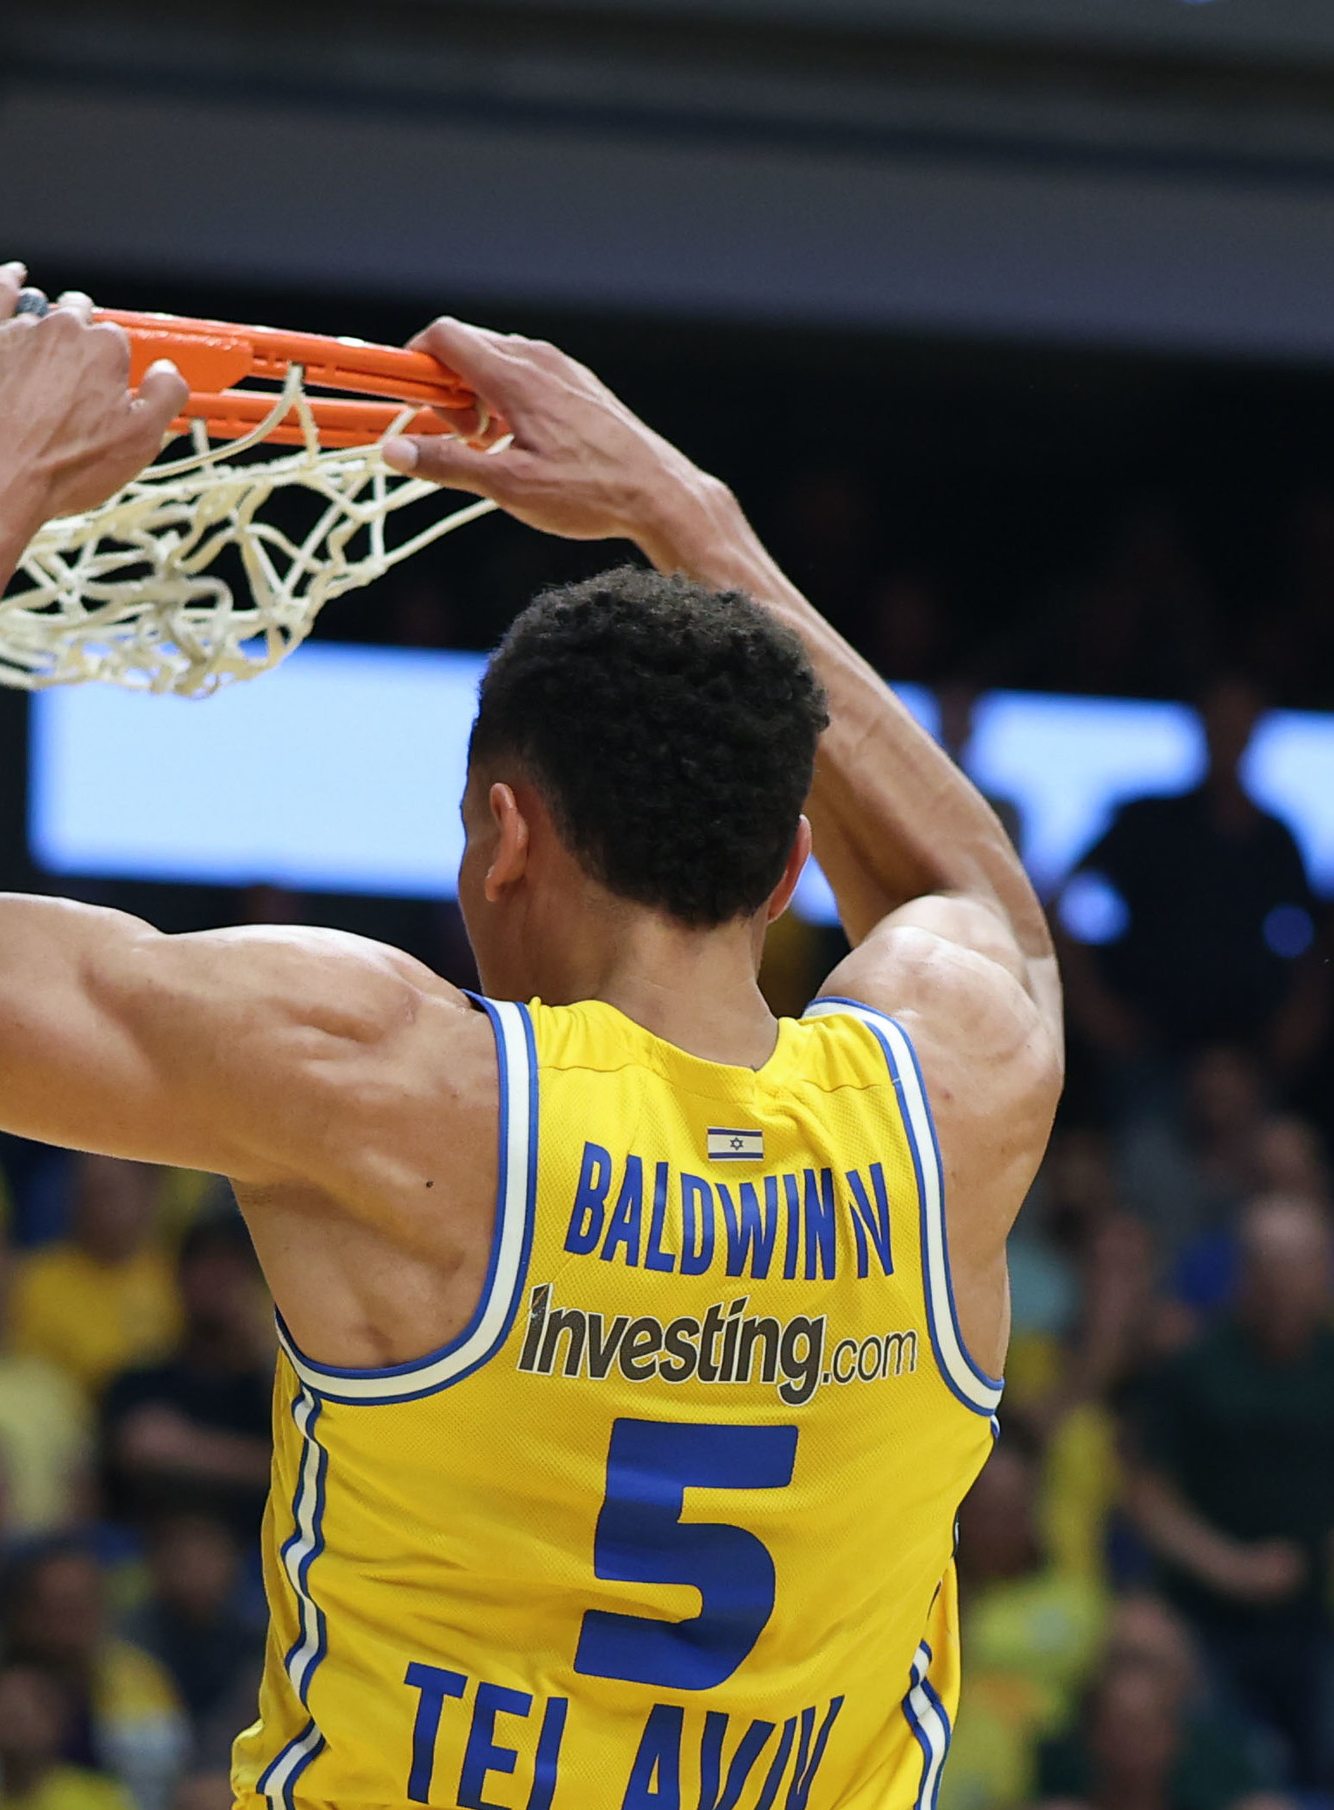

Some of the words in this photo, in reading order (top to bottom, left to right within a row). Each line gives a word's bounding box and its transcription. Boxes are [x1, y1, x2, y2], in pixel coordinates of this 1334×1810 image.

[564, 1141, 836, 1281] BALDWIN
[517, 1282, 918, 1406] Investing.com
[574, 1417, 799, 1691] 5
